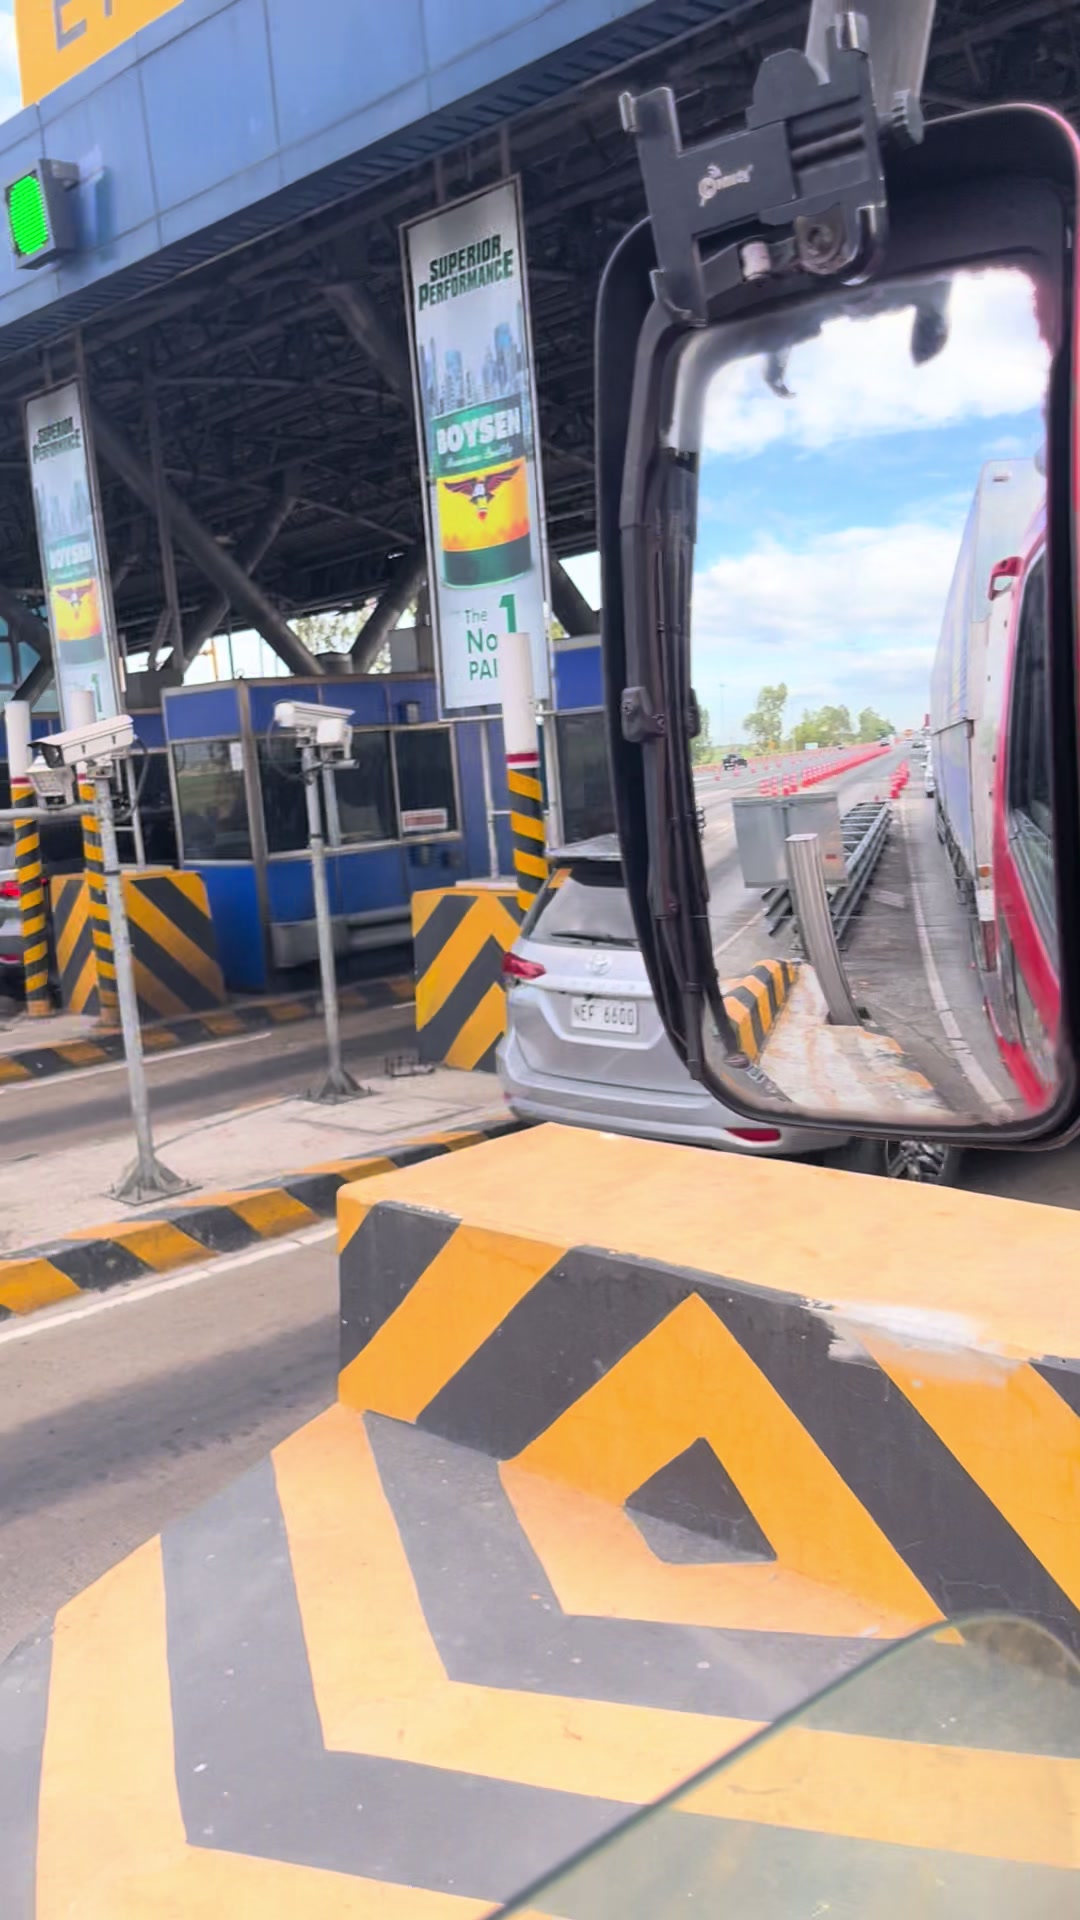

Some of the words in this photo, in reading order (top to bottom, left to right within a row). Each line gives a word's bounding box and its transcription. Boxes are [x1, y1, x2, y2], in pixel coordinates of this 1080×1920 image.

[418, 248, 514, 311] PERFORMANCE
[428, 234, 501, 282] SUPERIOR
[436, 406, 520, 455] BOYSEN
[464, 607, 488, 625] The
[498, 592, 517, 633] 1
[469, 657, 498, 681] PAI
